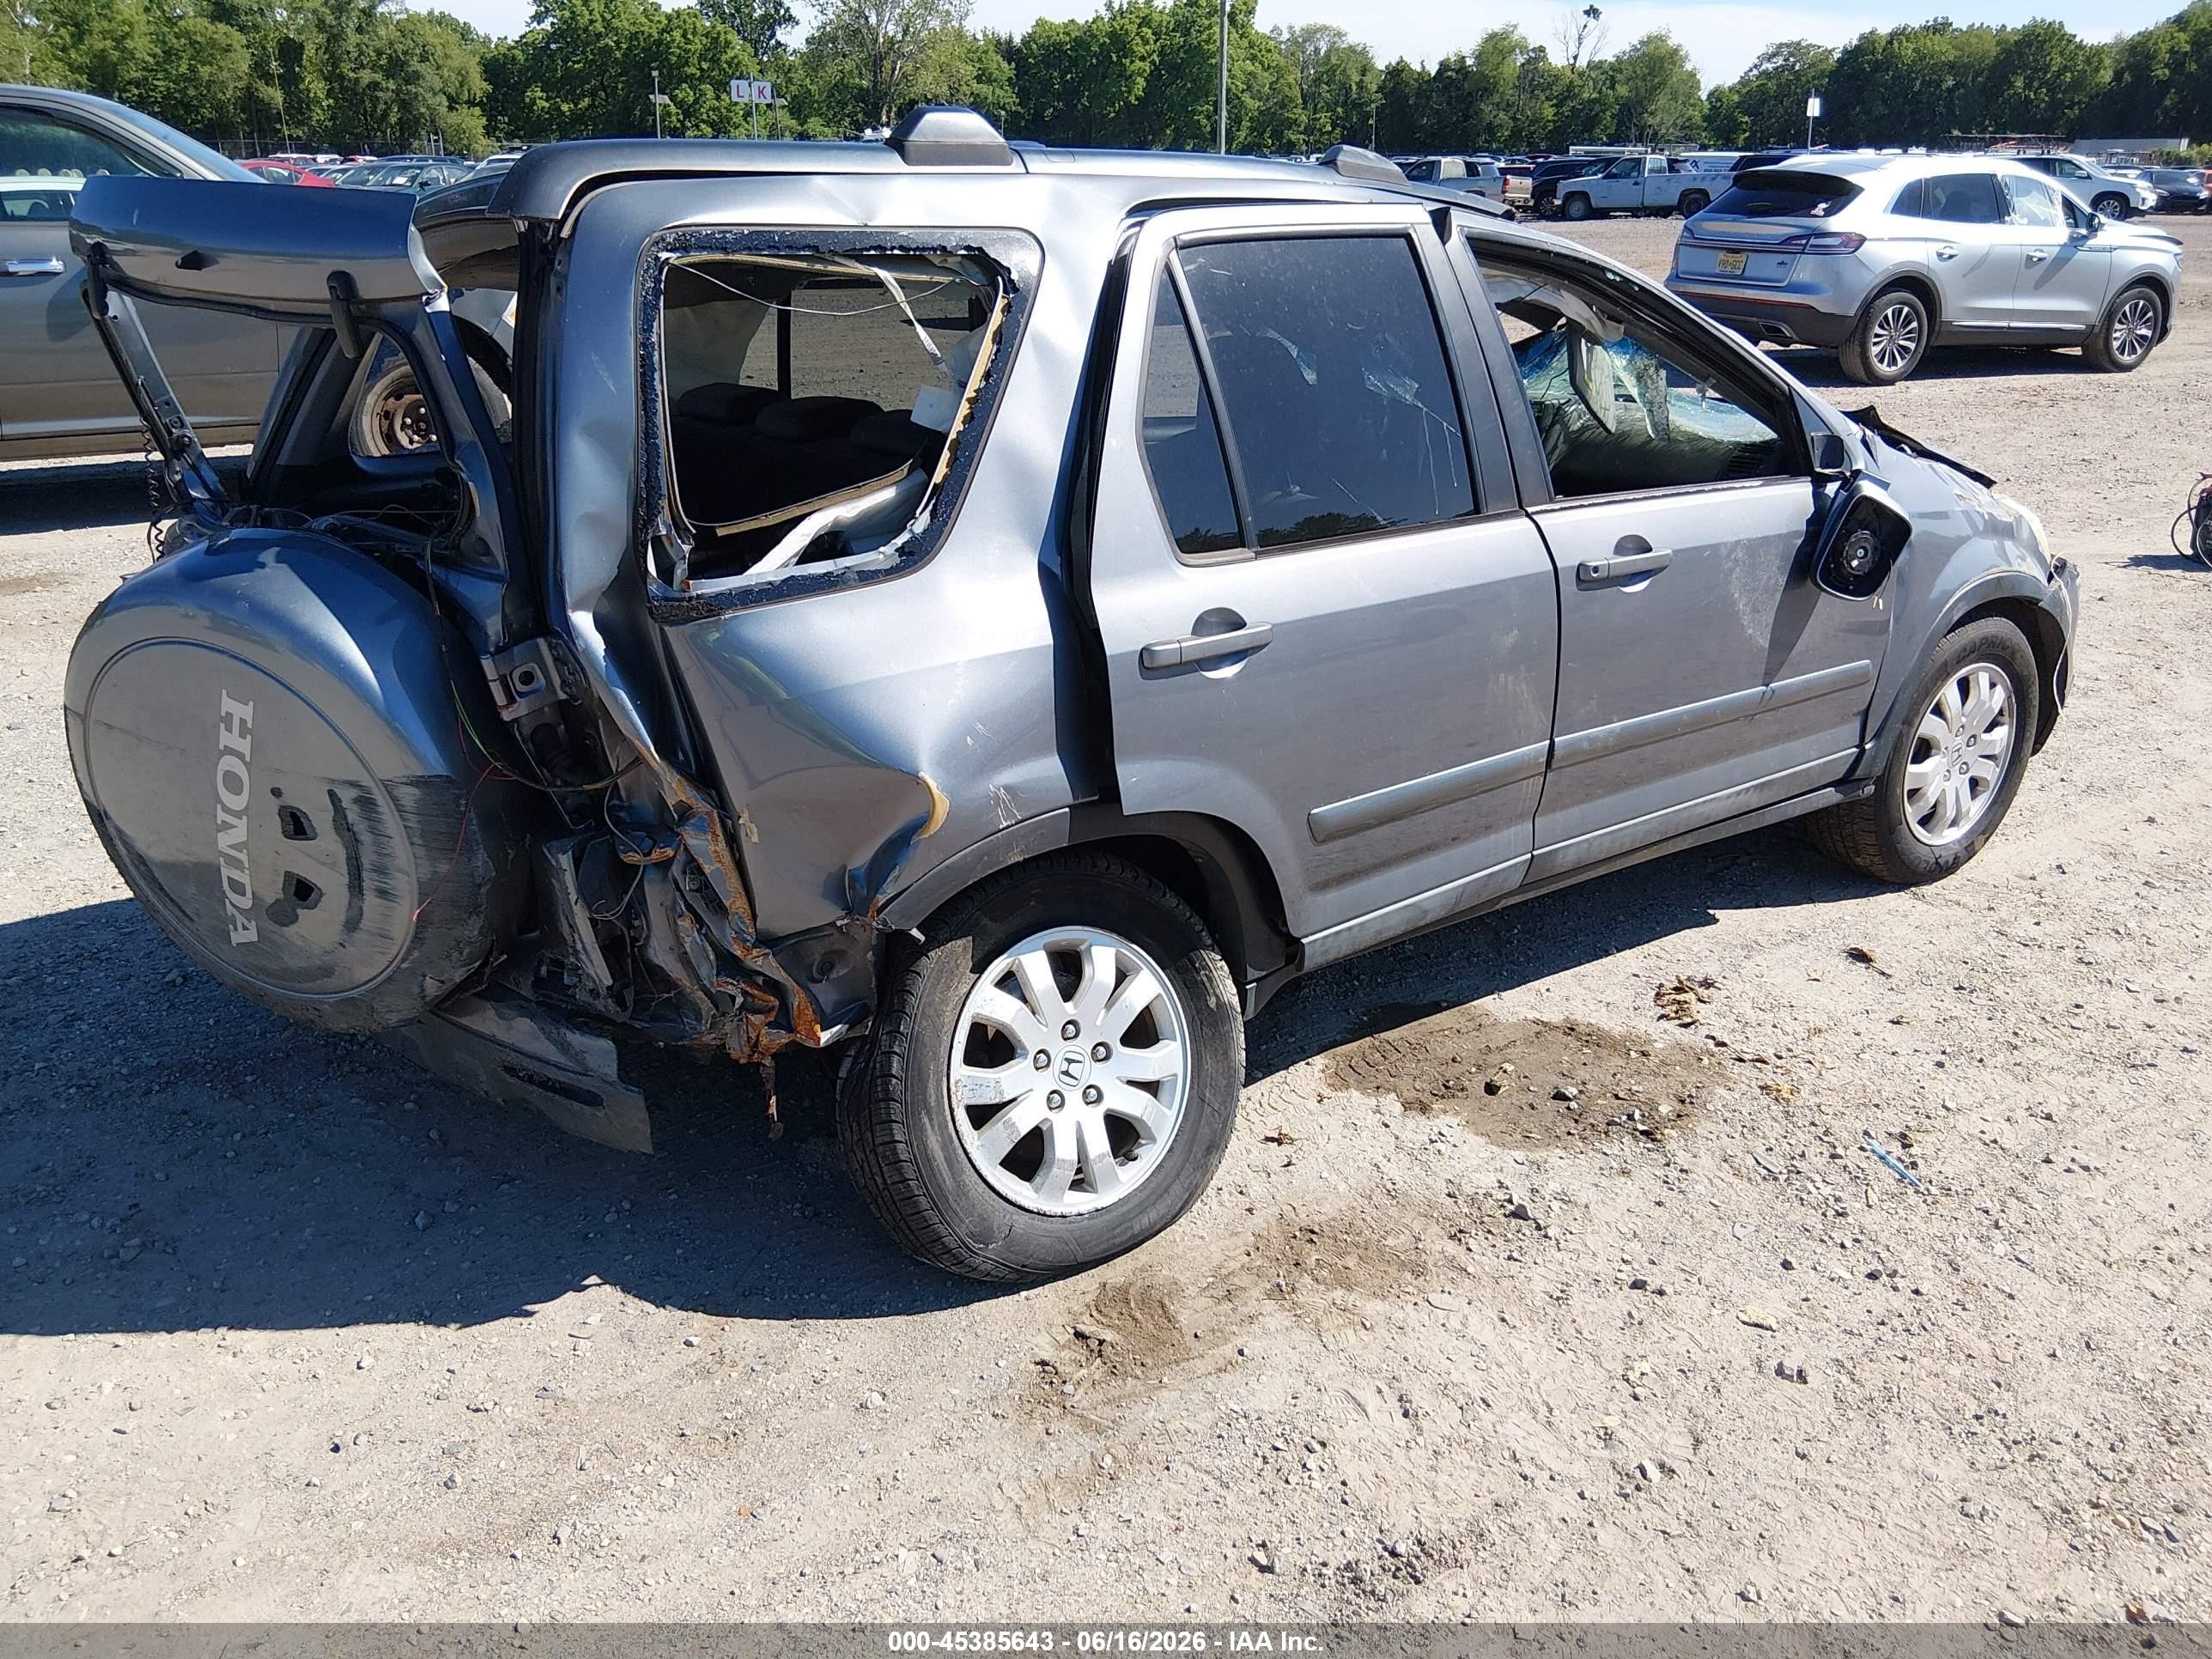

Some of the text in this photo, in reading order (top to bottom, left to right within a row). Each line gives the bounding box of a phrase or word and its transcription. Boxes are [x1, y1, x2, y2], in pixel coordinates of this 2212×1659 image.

[737, 84, 744, 98] L
[757, 85, 768, 100] K
[216, 688, 258, 947] HONDA
